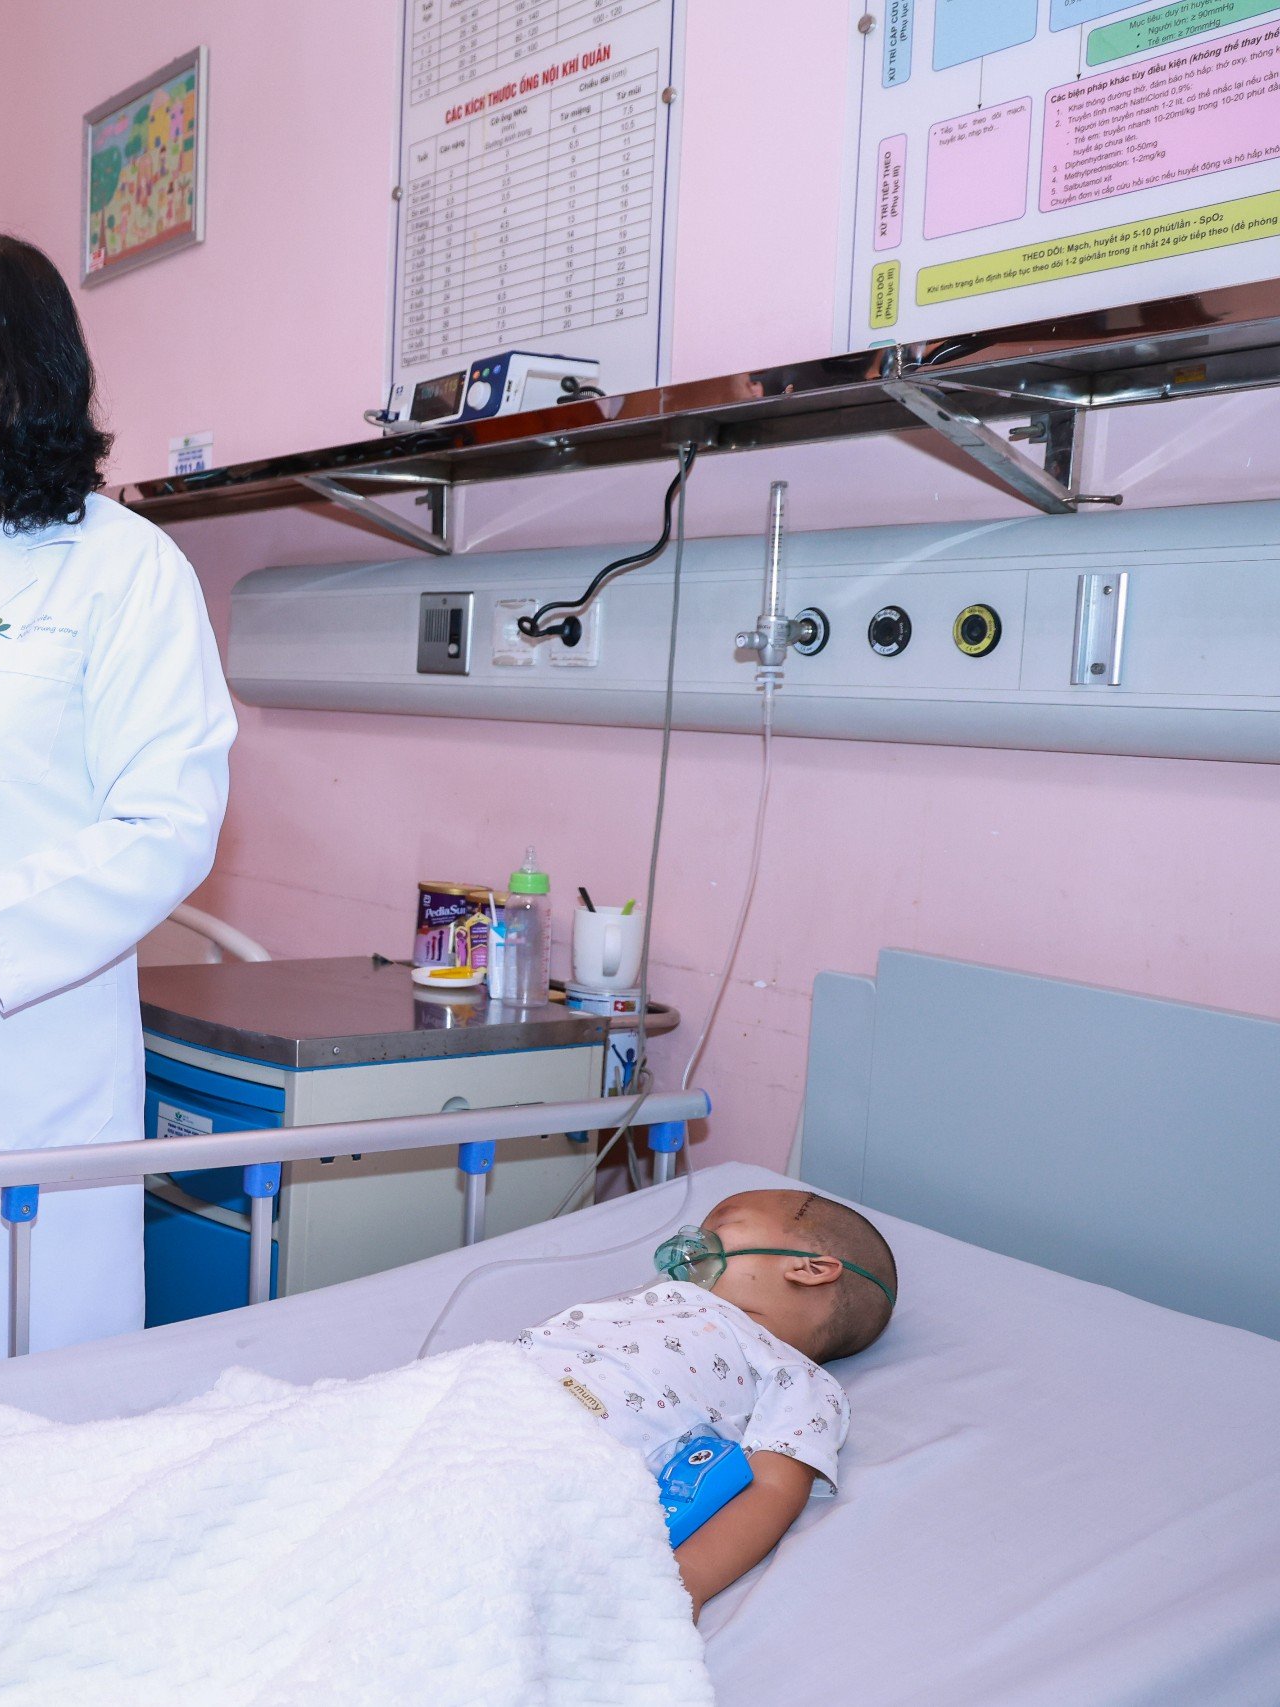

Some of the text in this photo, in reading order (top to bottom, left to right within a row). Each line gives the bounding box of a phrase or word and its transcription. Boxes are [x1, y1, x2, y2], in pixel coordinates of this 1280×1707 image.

[1164, 8, 1179, 18] duy
[1050, 94, 1066, 104] Các
[1067, 88, 1085, 99] biện
[1086, 81, 1108, 95] pháp
[1109, 75, 1130, 86] khác
[1147, 63, 1166, 75] điều
[1168, 58, 1187, 69] kiện
[1189, 48, 1222, 64] (không
[1240, 35, 1262, 48] thay
[445, 42, 610, 124] CÁC KÍCH THƯỚC ỐNG NỘI KHÍ QUẢN
[1107, 101, 1128, 112] mạch
[1127, 118, 1151, 130] nhanh
[1154, 107, 1195, 122] 10-20ml/kg
[1197, 100, 1218, 111] trong
[1221, 92, 1244, 104] 10-20
[1135, 104, 1159, 116] nhanh
[1161, 99, 1174, 109] 1-2
[1186, 93, 1197, 103] có
[1126, 140, 1158, 153] 10-50mg
[1132, 150, 1166, 163] 1-2mg/kg
[1022, 250, 1045, 261] THEO
[1066, 241, 1091, 252] Mạch,
[1093, 234, 1118, 246] huyết
[1119, 233, 1131, 241] áp
[1132, 227, 1152, 239] 5-10
[1153, 219, 1191, 235] phút/lần
[1032, 263, 1050, 272] theo
[1065, 256, 1077, 265] 1-2
[1108, 247, 1130, 257] trong
[1160, 237, 1171, 246] 24
[1208, 226, 1229, 236] theo
[1247, 216, 1278, 229] phòng
[875, 292, 883, 318] THEO
